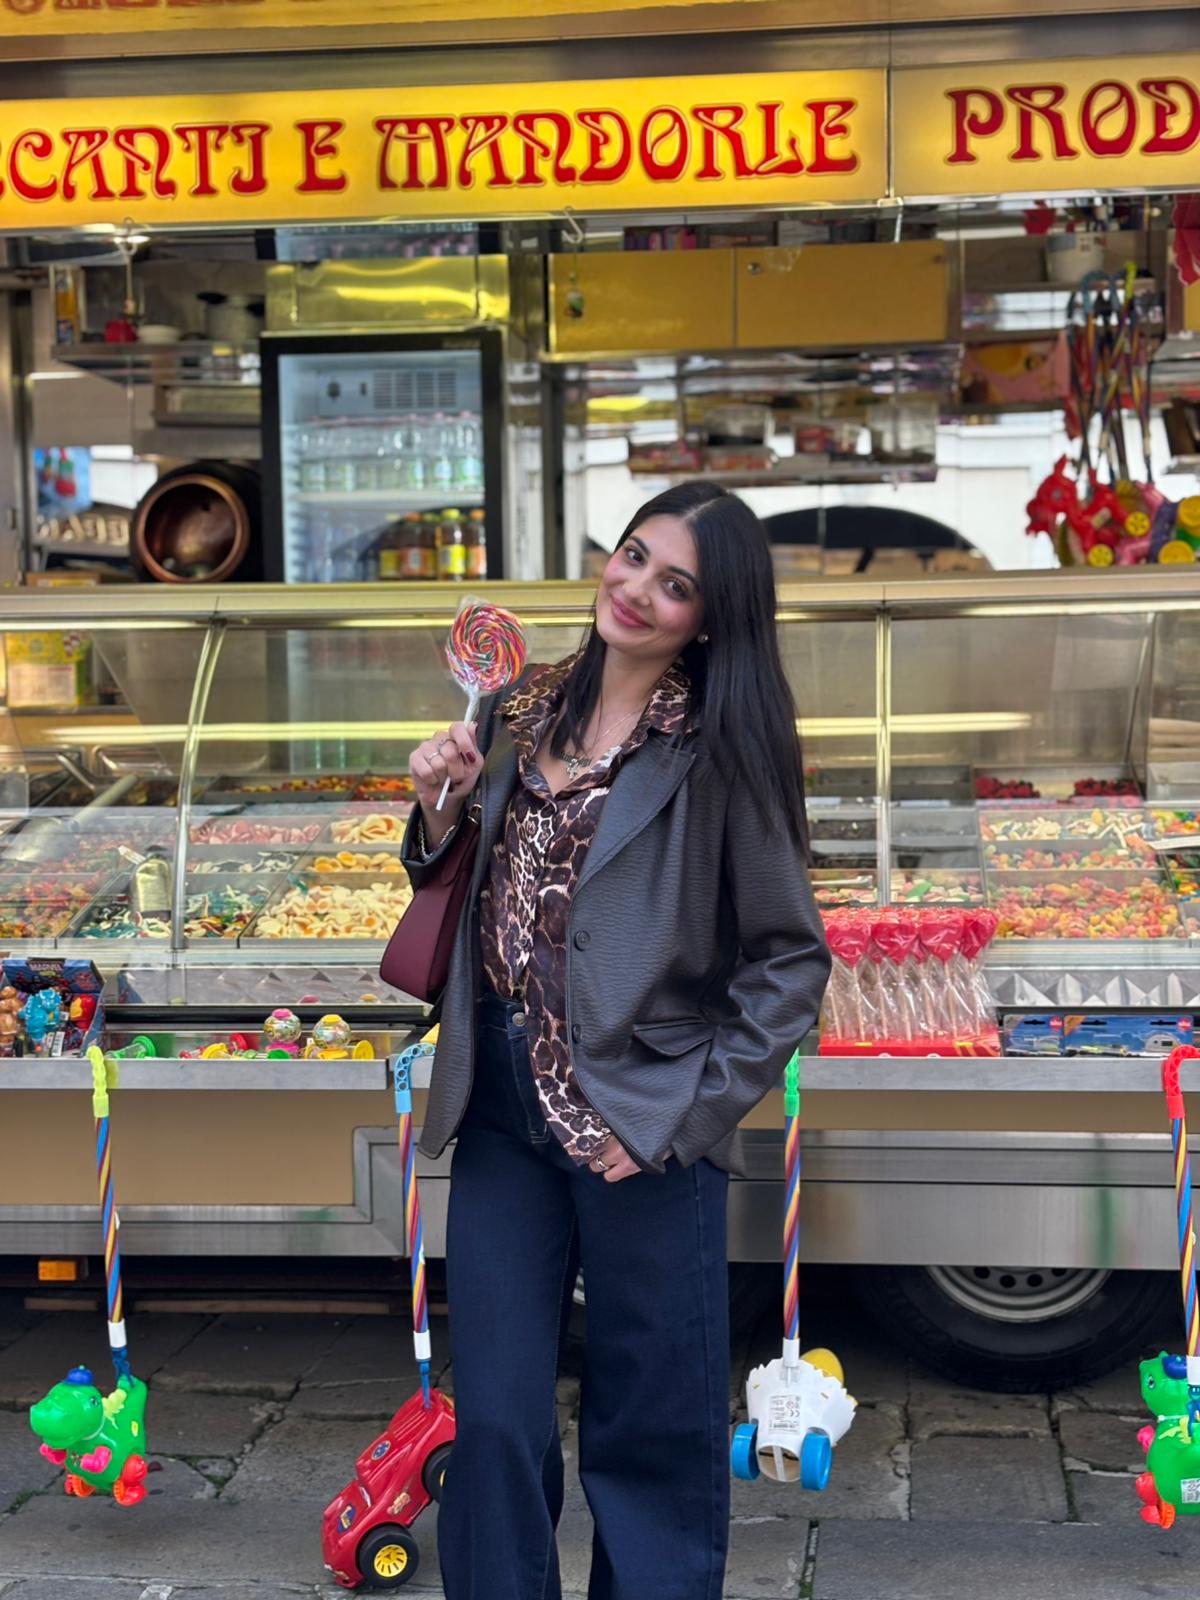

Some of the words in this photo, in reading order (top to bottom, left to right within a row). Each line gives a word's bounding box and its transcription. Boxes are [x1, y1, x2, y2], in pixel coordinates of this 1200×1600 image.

[296, 120, 347, 193] E
[375, 99, 858, 190] MANDORLE
[945, 78, 1200, 165] PROD
